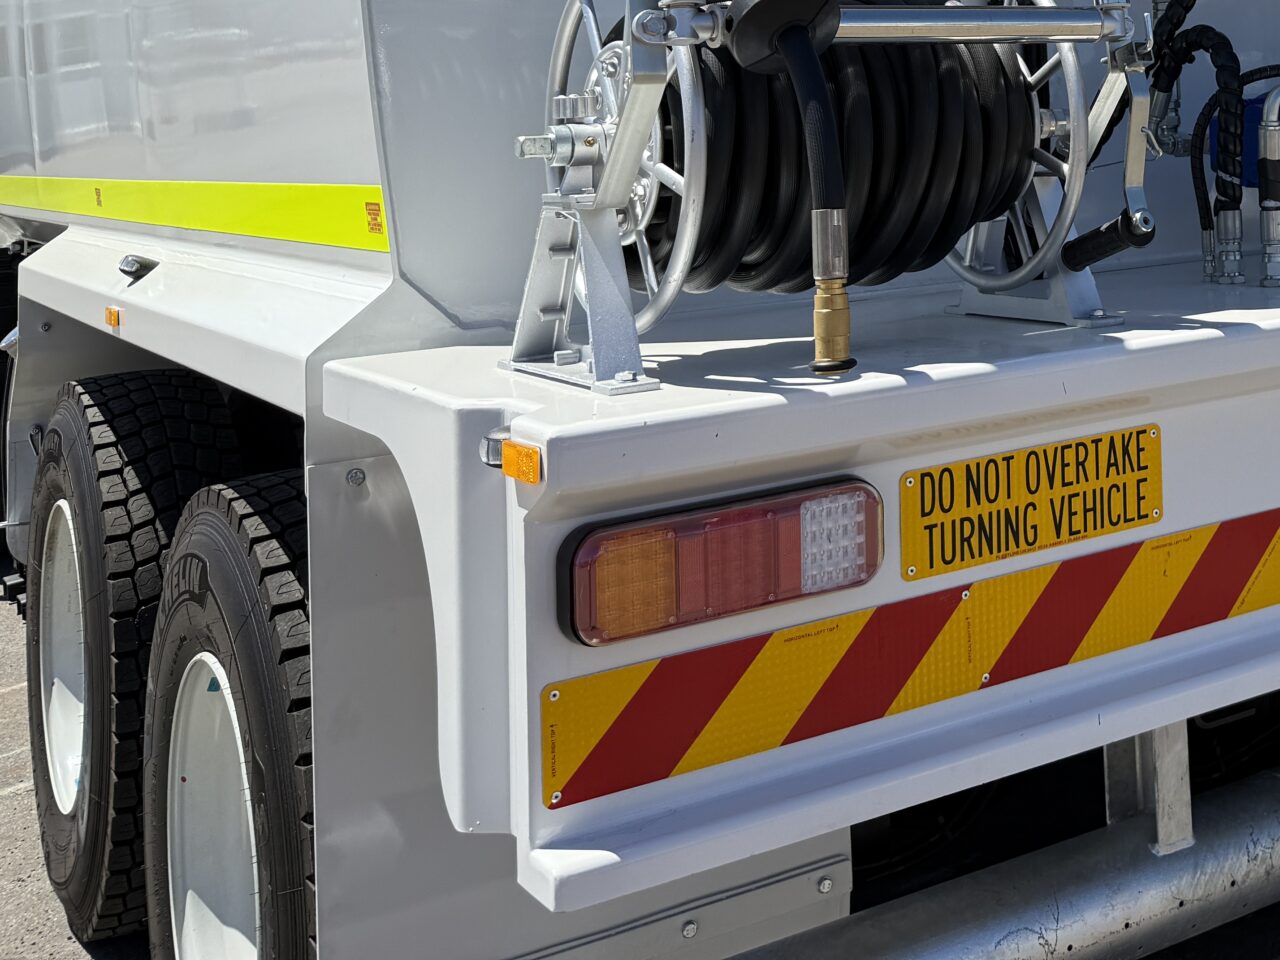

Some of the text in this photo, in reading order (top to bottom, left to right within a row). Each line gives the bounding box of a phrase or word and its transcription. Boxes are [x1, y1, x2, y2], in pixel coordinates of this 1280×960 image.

[920, 429, 1149, 518] DO NOT OVERTAKE
[924, 477, 1149, 569] TURNING VEHICLE
